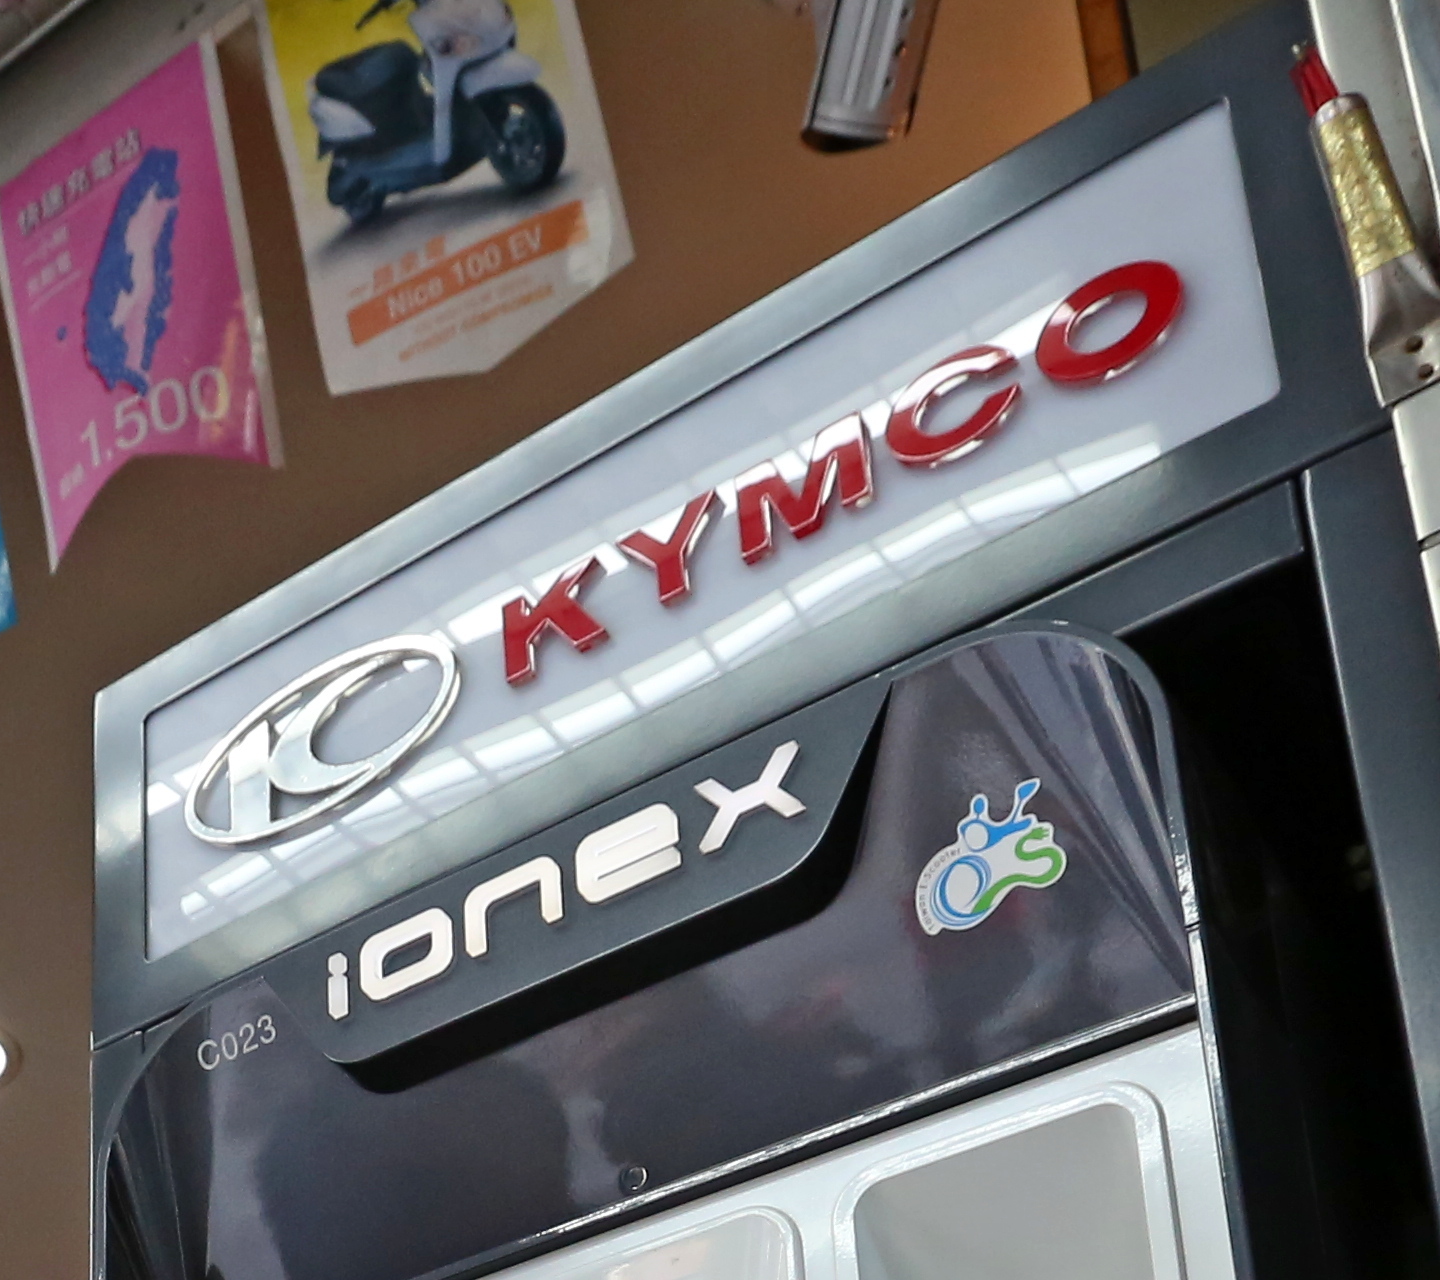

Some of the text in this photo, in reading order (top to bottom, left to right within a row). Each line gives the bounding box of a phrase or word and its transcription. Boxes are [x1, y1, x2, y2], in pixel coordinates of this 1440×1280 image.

[386, 277, 444, 320] Nice
[452, 243, 502, 286] 100
[507, 224, 543, 262] EV
[501, 259, 1186, 686] KYMCO
[325, 739, 807, 1021] ionex
[197, 1014, 277, 1071] C023
